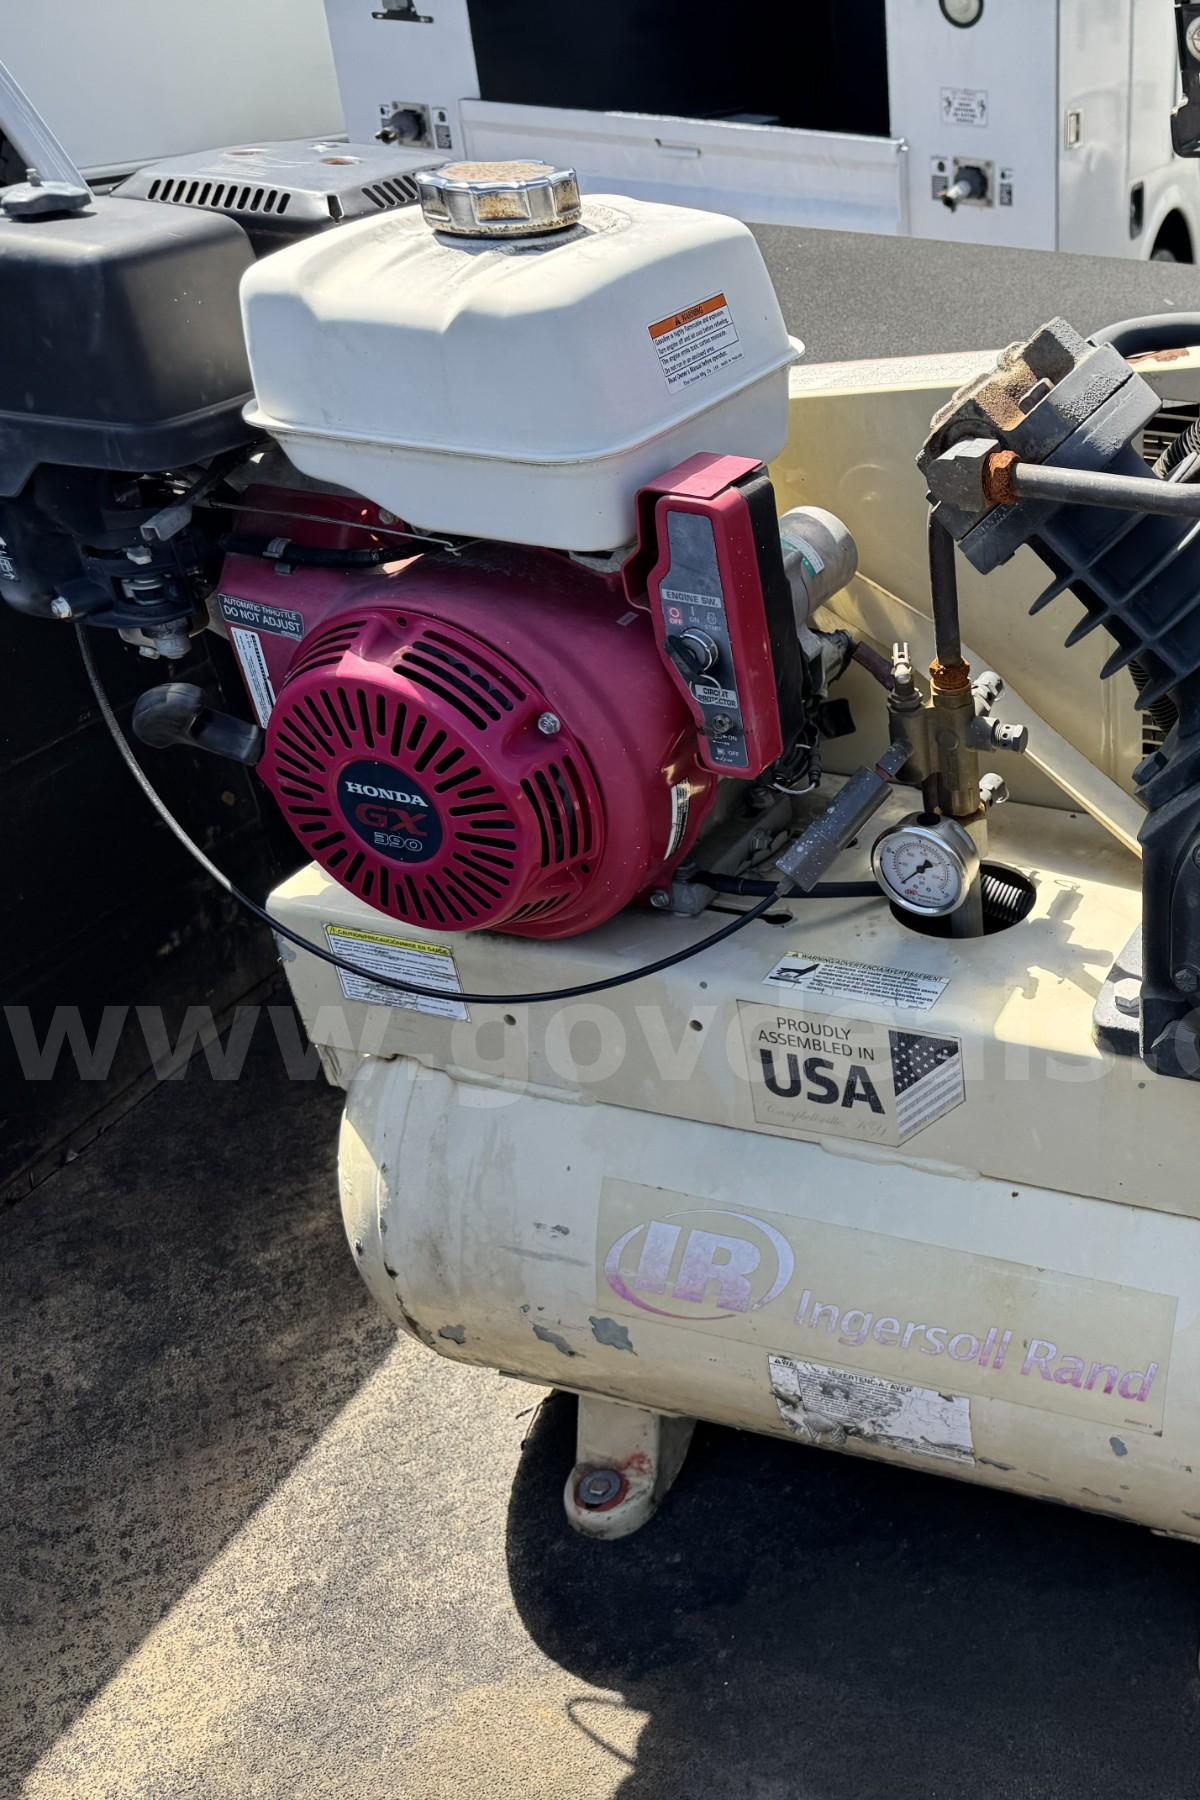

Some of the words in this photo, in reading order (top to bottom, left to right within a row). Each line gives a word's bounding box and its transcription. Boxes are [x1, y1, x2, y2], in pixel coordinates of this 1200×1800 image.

[222, 596, 260, 612] AUTOMATIC
[260, 605, 296, 620] THROTTLE
[667, 591, 699, 603] ENGINE
[223, 604, 238, 617] DO
[239, 608, 260, 622] NOT
[261, 614, 300, 632] ADJUST
[703, 687, 729, 698] CIRCUIT
[345, 781, 429, 807] HONDA
[355, 803, 428, 837] GX
[374, 832, 423, 852] 390
[777, 1017, 851, 1040] PROUDLY
[758, 1030, 853, 1056] ASSEMBLED
[858, 1047, 875, 1061] IN
[760, 1049, 886, 1115] USA
[794, 1289, 1012, 1370] Ingersoll
[1020, 1338, 1159, 1402] Rand
